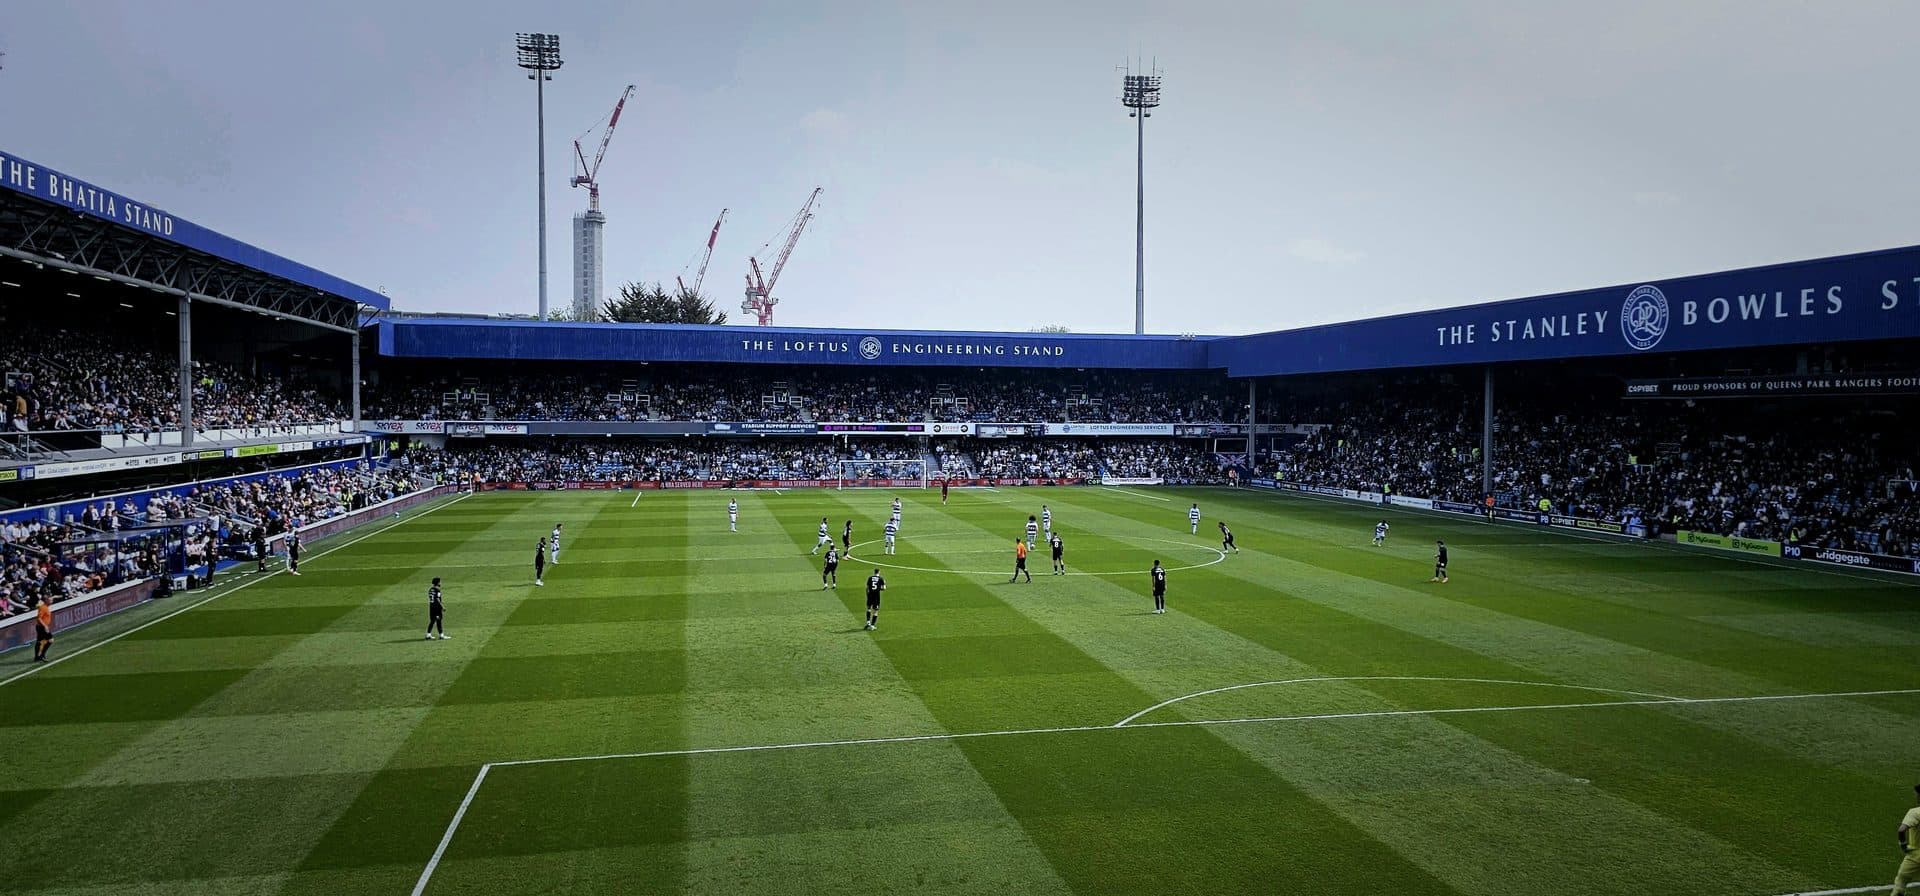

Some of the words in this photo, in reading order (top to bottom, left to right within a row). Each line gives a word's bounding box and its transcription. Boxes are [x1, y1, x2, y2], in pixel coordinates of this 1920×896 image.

[0, 156, 35, 189] THE
[50, 174, 116, 217] BHATIA
[125, 202, 173, 236] STAND
[1683, 285, 1843, 326] BOWLES
[1437, 324, 1475, 346] THE
[1492, 310, 1608, 342] STANLEY
[743, 341, 774, 350] THE
[784, 341, 848, 352] LOFTUS
[893, 343, 1004, 355] ENGINEERING
[1014, 346, 1064, 356] STAND
[1703, 382, 1747, 390] SPONSORS
[1750, 382, 1761, 390] OF
[1766, 381, 1802, 390] QUEENS
[1807, 380, 1831, 388] PARK
[1835, 379, 1882, 388] RANGERS
[1888, 378, 1920, 386] FOOT
[1784, 546, 1800, 556] P10
[871, 581, 878, 590] 5
